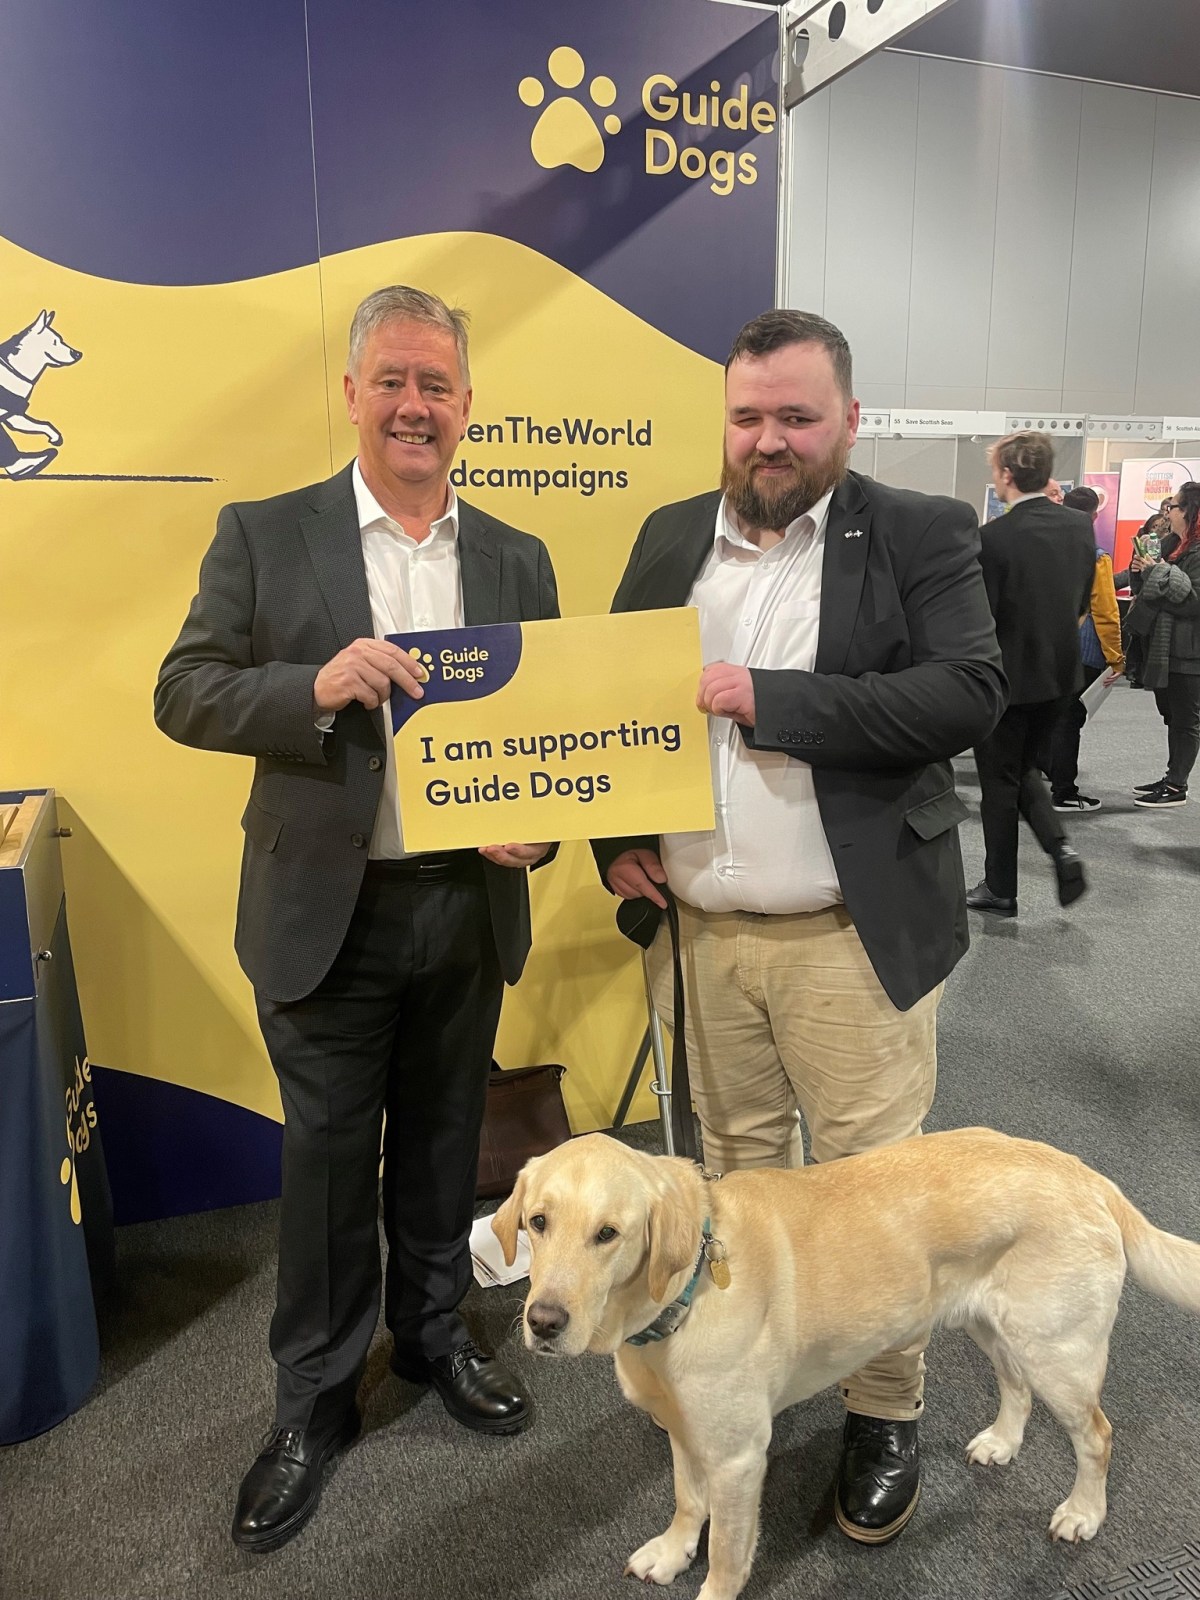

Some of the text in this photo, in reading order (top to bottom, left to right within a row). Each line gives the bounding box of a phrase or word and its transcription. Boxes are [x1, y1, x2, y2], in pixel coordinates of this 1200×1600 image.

[642, 74, 777, 134] Guide
[645, 128, 758, 196] Dogs
[459, 416, 652, 446] enTheWorld
[1146, 472, 1174, 480] SCOTTISH
[439, 647, 489, 665] Guide
[442, 665, 485, 682] Dogs
[420, 720, 681, 764] I am supporting
[425, 770, 612, 806] Guide Dogs
